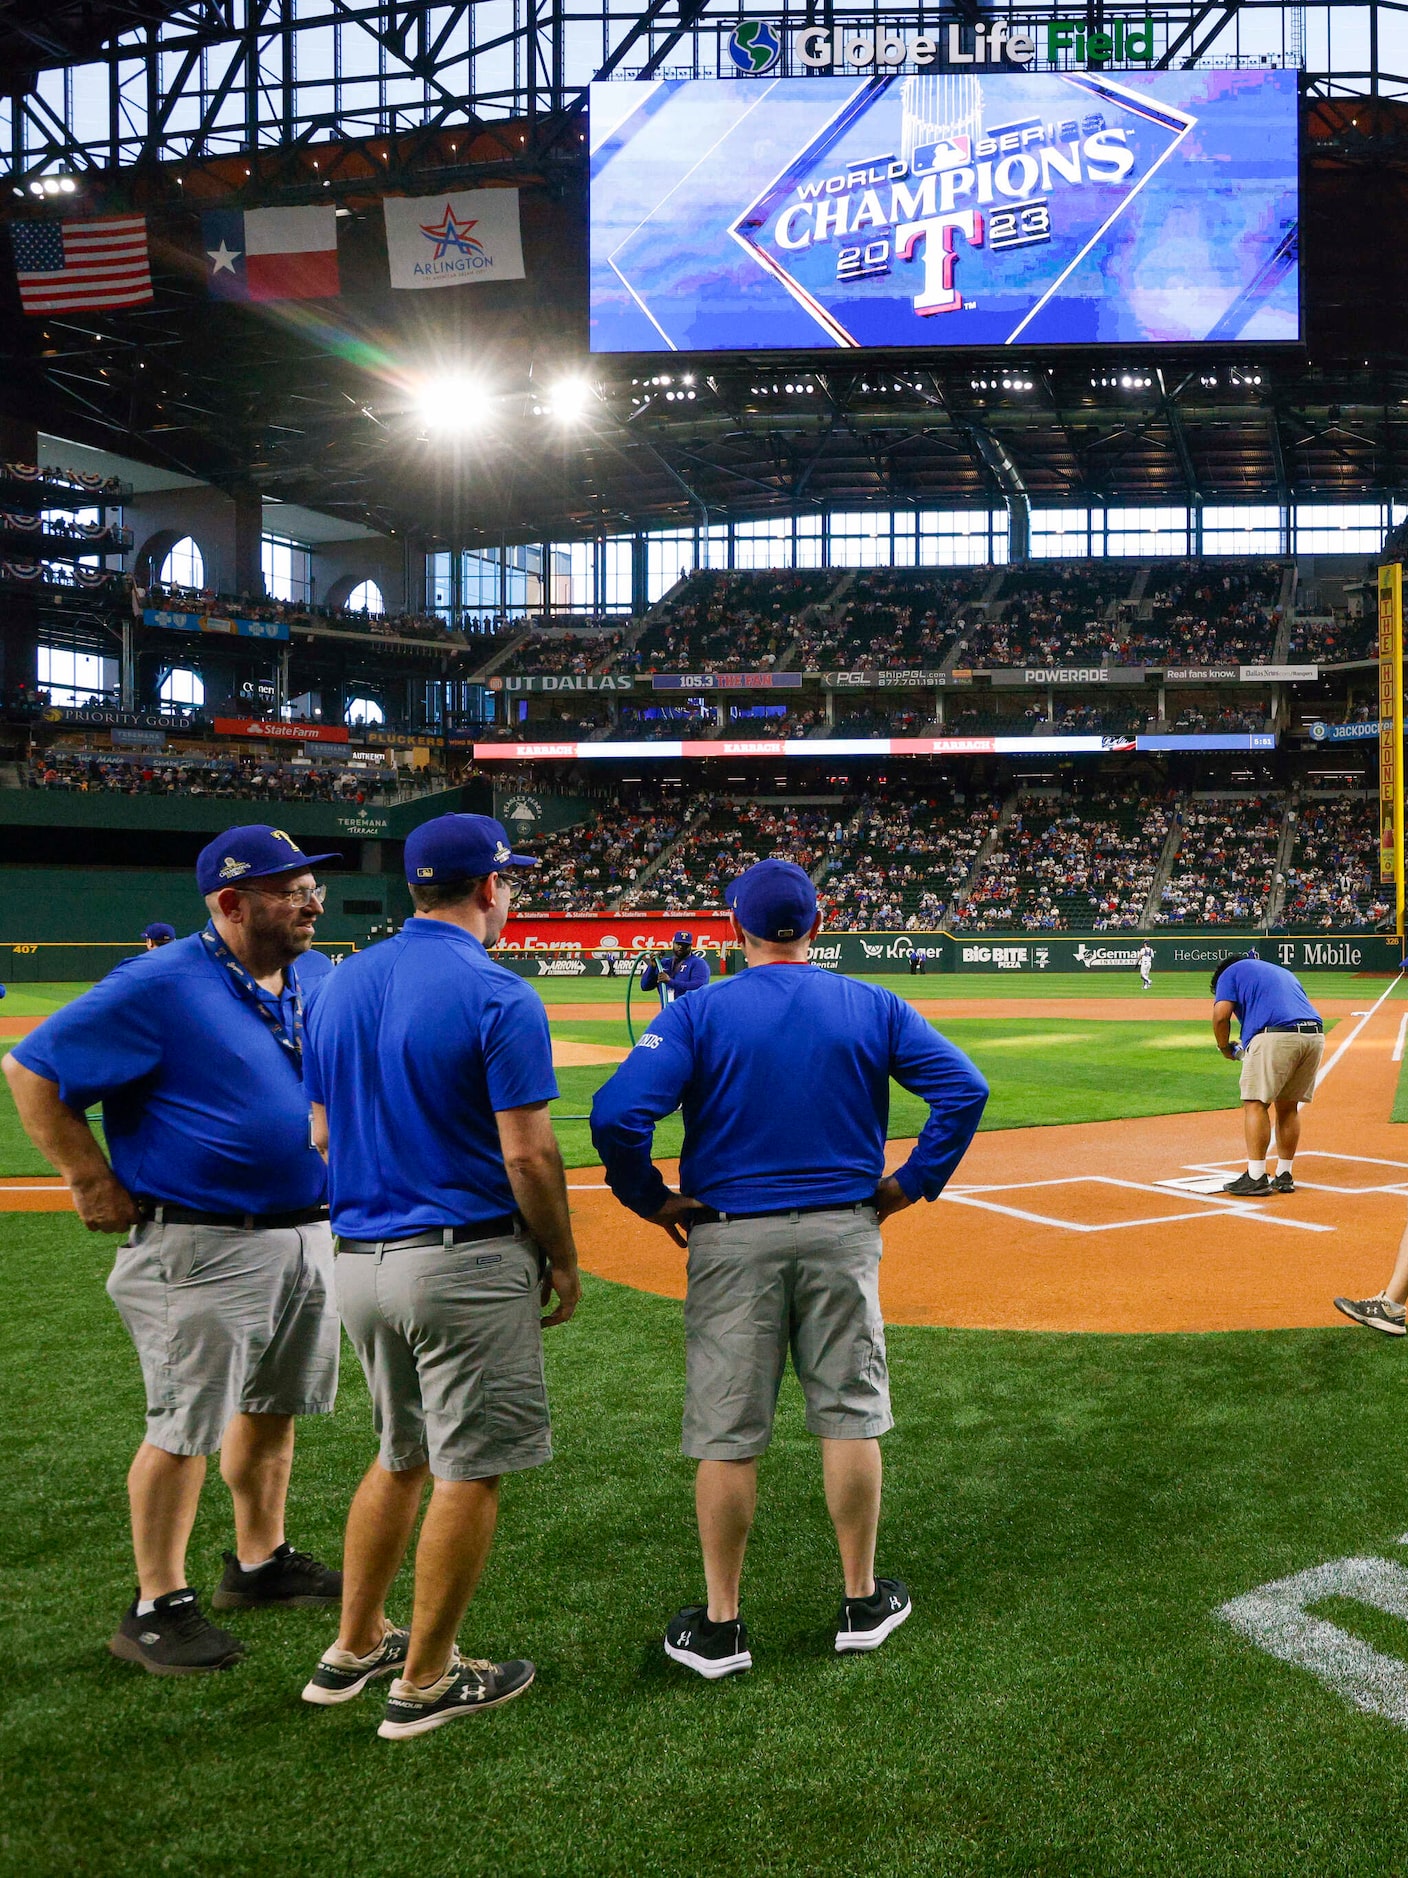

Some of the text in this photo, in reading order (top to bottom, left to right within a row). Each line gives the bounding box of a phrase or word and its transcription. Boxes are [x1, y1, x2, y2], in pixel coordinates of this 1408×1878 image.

[799, 19, 1154, 68] Globe Life Field
[797, 158, 909, 200] WORLD
[774, 127, 1136, 250] CHAMPIONS
[836, 206, 1050, 272] 20 23
[413, 256, 494, 276] ARLINGTON
[895, 209, 984, 317] T
[836, 671, 871, 684] PGL
[878, 670, 946, 679] ShipPGL.com
[1024, 669, 1109, 683] POWERADE
[1167, 668, 1236, 679] Real fans know.
[505, 676, 536, 691] UT
[541, 675, 632, 690] DALLAS
[679, 675, 714, 688] 105.3
[717, 675, 743, 688] THE
[878, 678, 946, 687] 877.701.1919
[64, 709, 191, 729] PRIORITY GOLD
[368, 732, 446, 747] PLUCKERS
[932, 740, 990, 751] KARBACH
[516, 745, 573, 756] KARBACH
[723, 743, 781, 753] KARBACH
[337, 817, 388, 828] TEREMANA
[1385, 938, 1399, 946] 326
[12, 945, 38, 954] 407
[992, 947, 1028, 963] BITE
[1278, 943, 1362, 966] T Mobile
[549, 960, 579, 971] ARROW
[997, 961, 1022, 969] PIZZA
